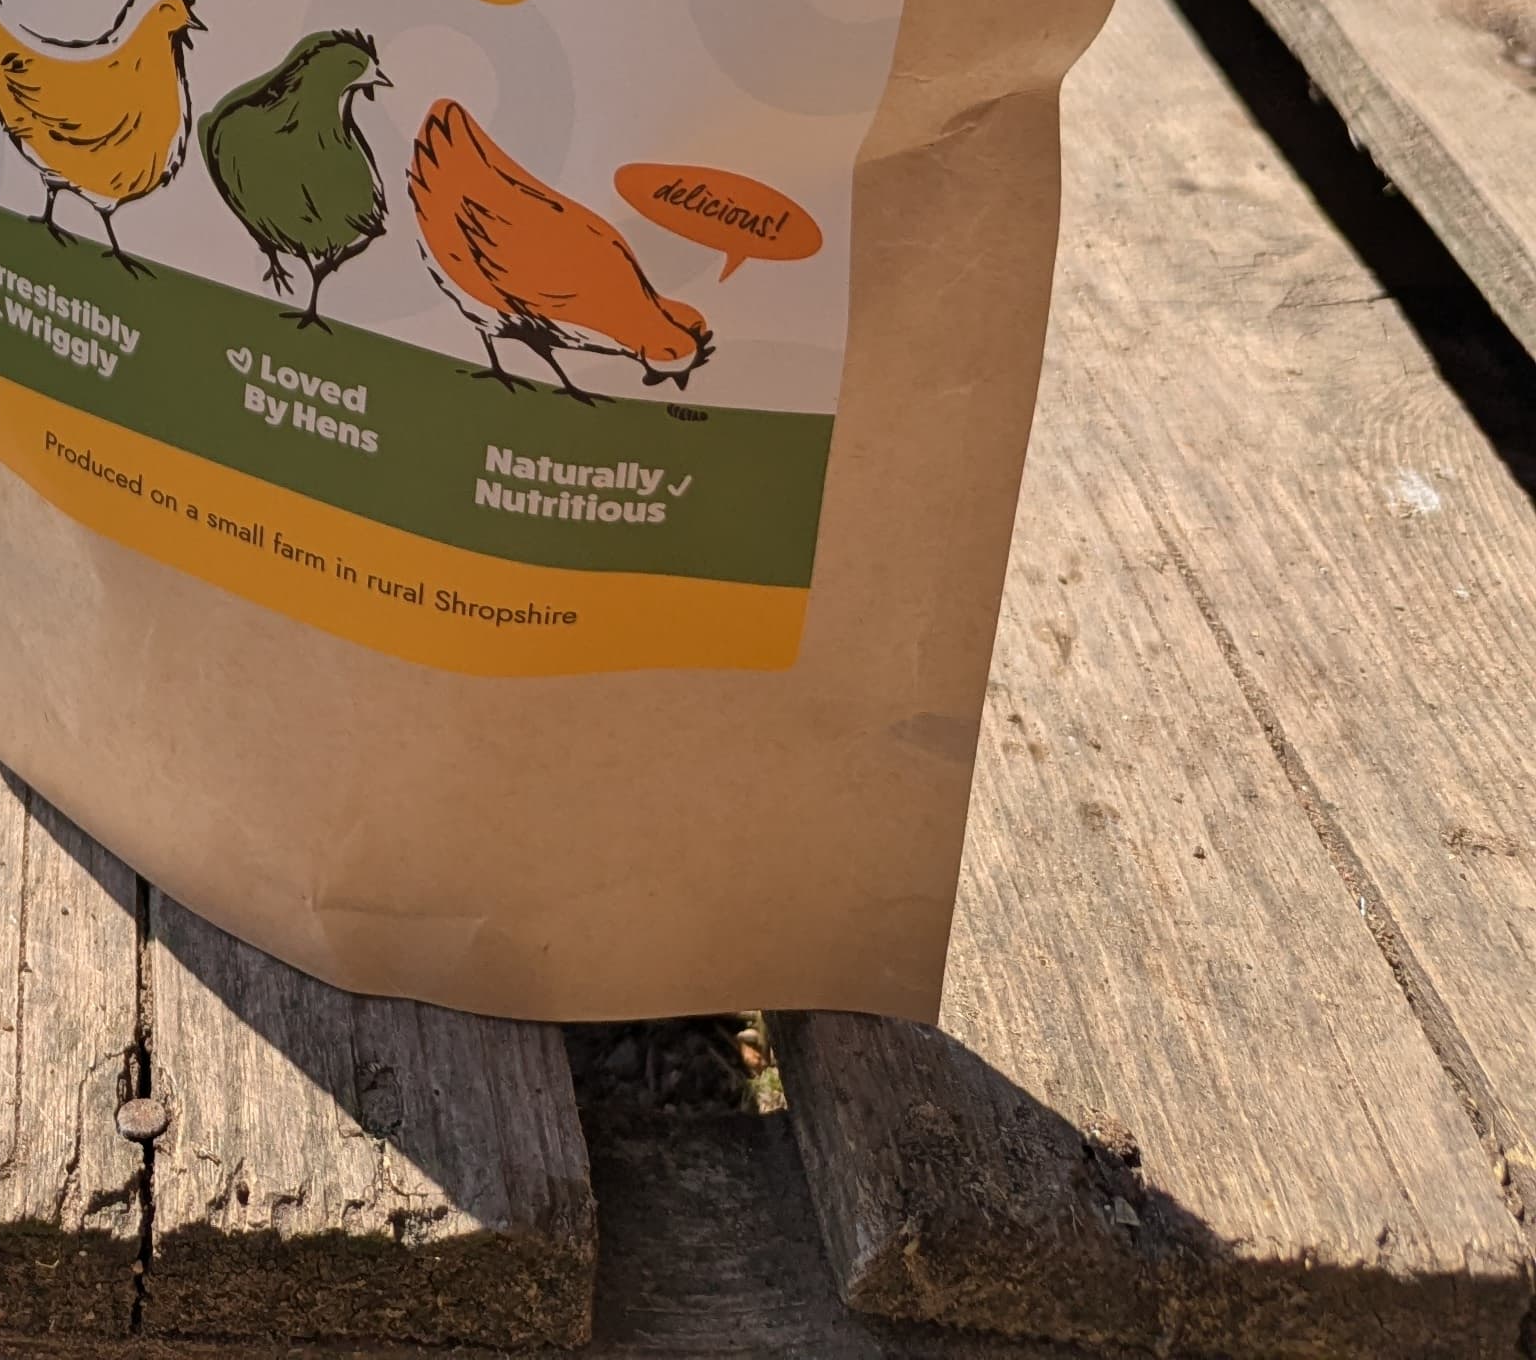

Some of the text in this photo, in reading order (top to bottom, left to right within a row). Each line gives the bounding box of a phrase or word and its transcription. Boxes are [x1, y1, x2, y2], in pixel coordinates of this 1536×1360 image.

[652, 177, 791, 241] delicious!
[3, 295, 120, 378] Wriggly
[260, 353, 368, 415] Loved
[243, 382, 380, 453] By Hens
[474, 477, 667, 524] Nutritious
[484, 444, 665, 497] Naturally
[44, 430, 578, 628] Produced on a small farm in rural Shropshire
